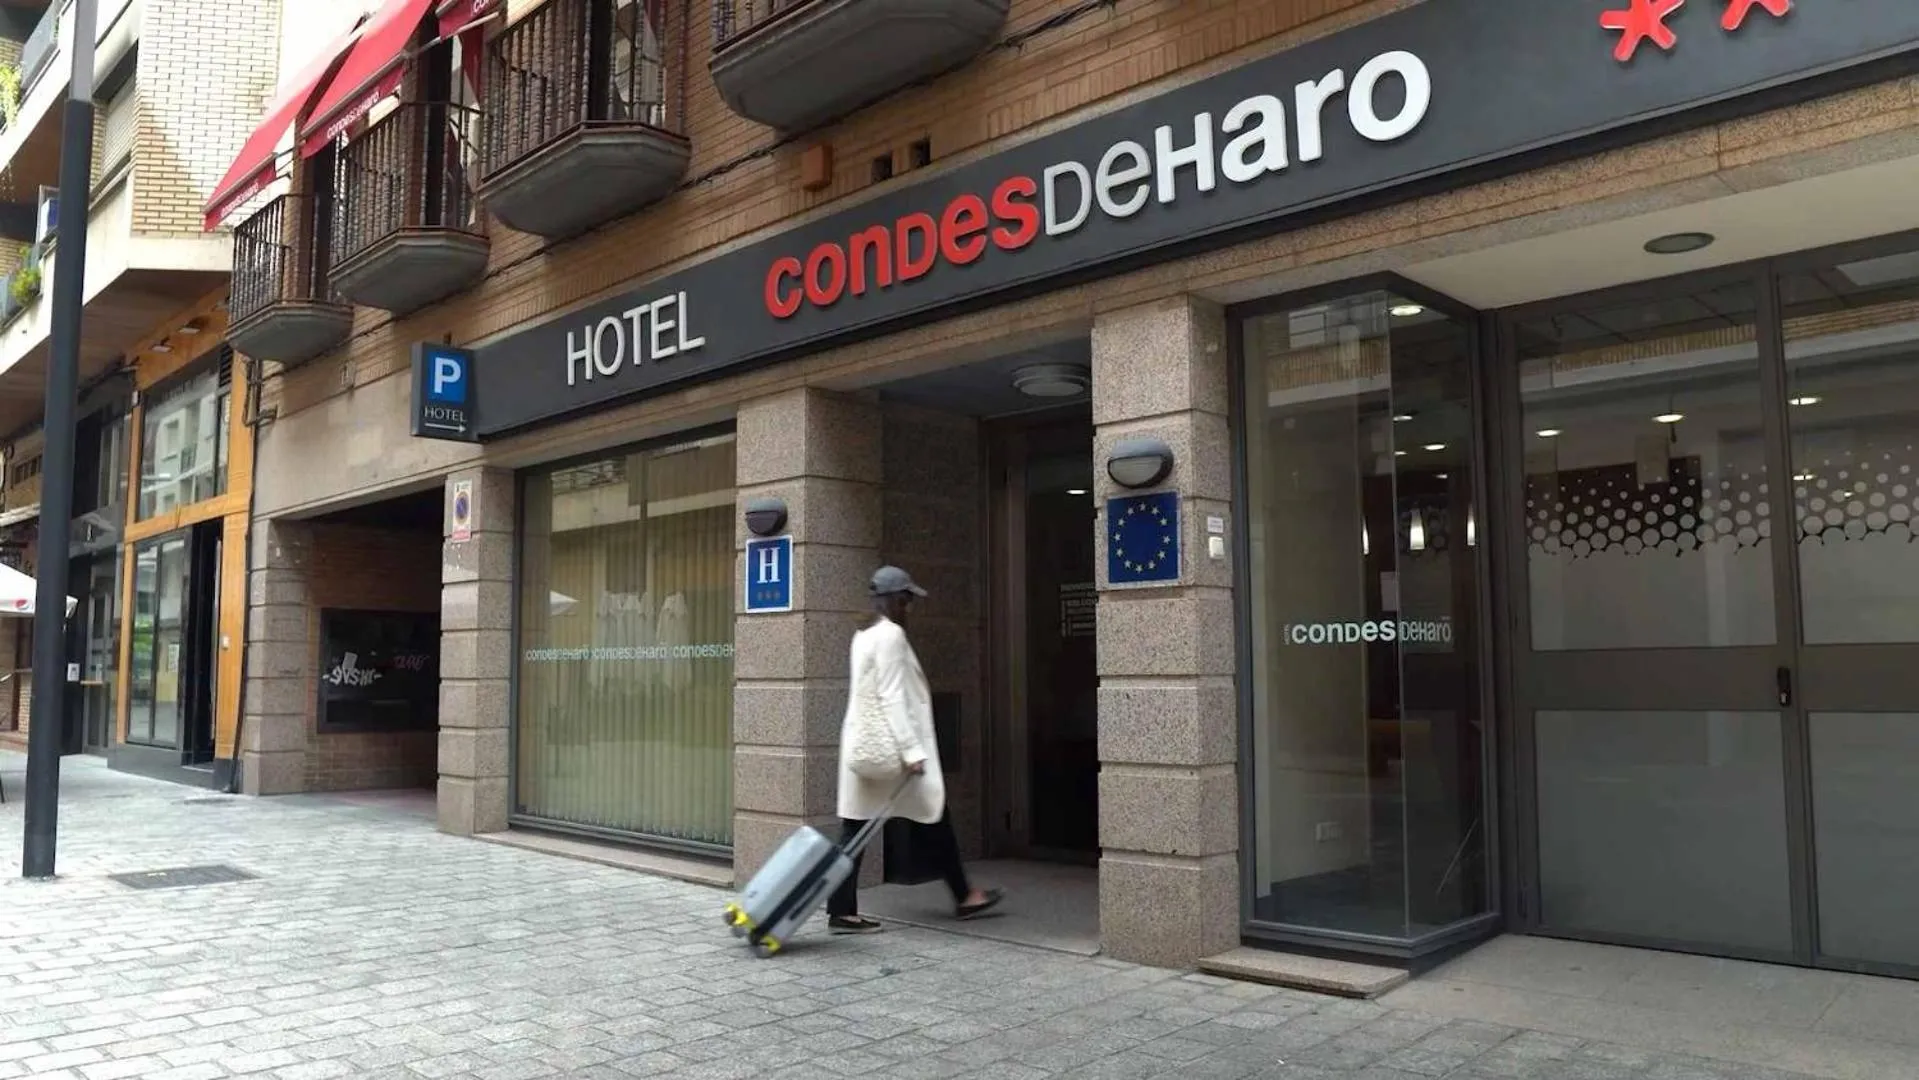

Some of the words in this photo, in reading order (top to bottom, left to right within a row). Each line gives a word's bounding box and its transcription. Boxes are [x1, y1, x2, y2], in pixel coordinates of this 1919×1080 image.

[566, 290, 706, 387] HOTEL
[434, 356, 462, 394] P
[424, 405, 468, 422] HOTEL
[757, 546, 781, 584] H
